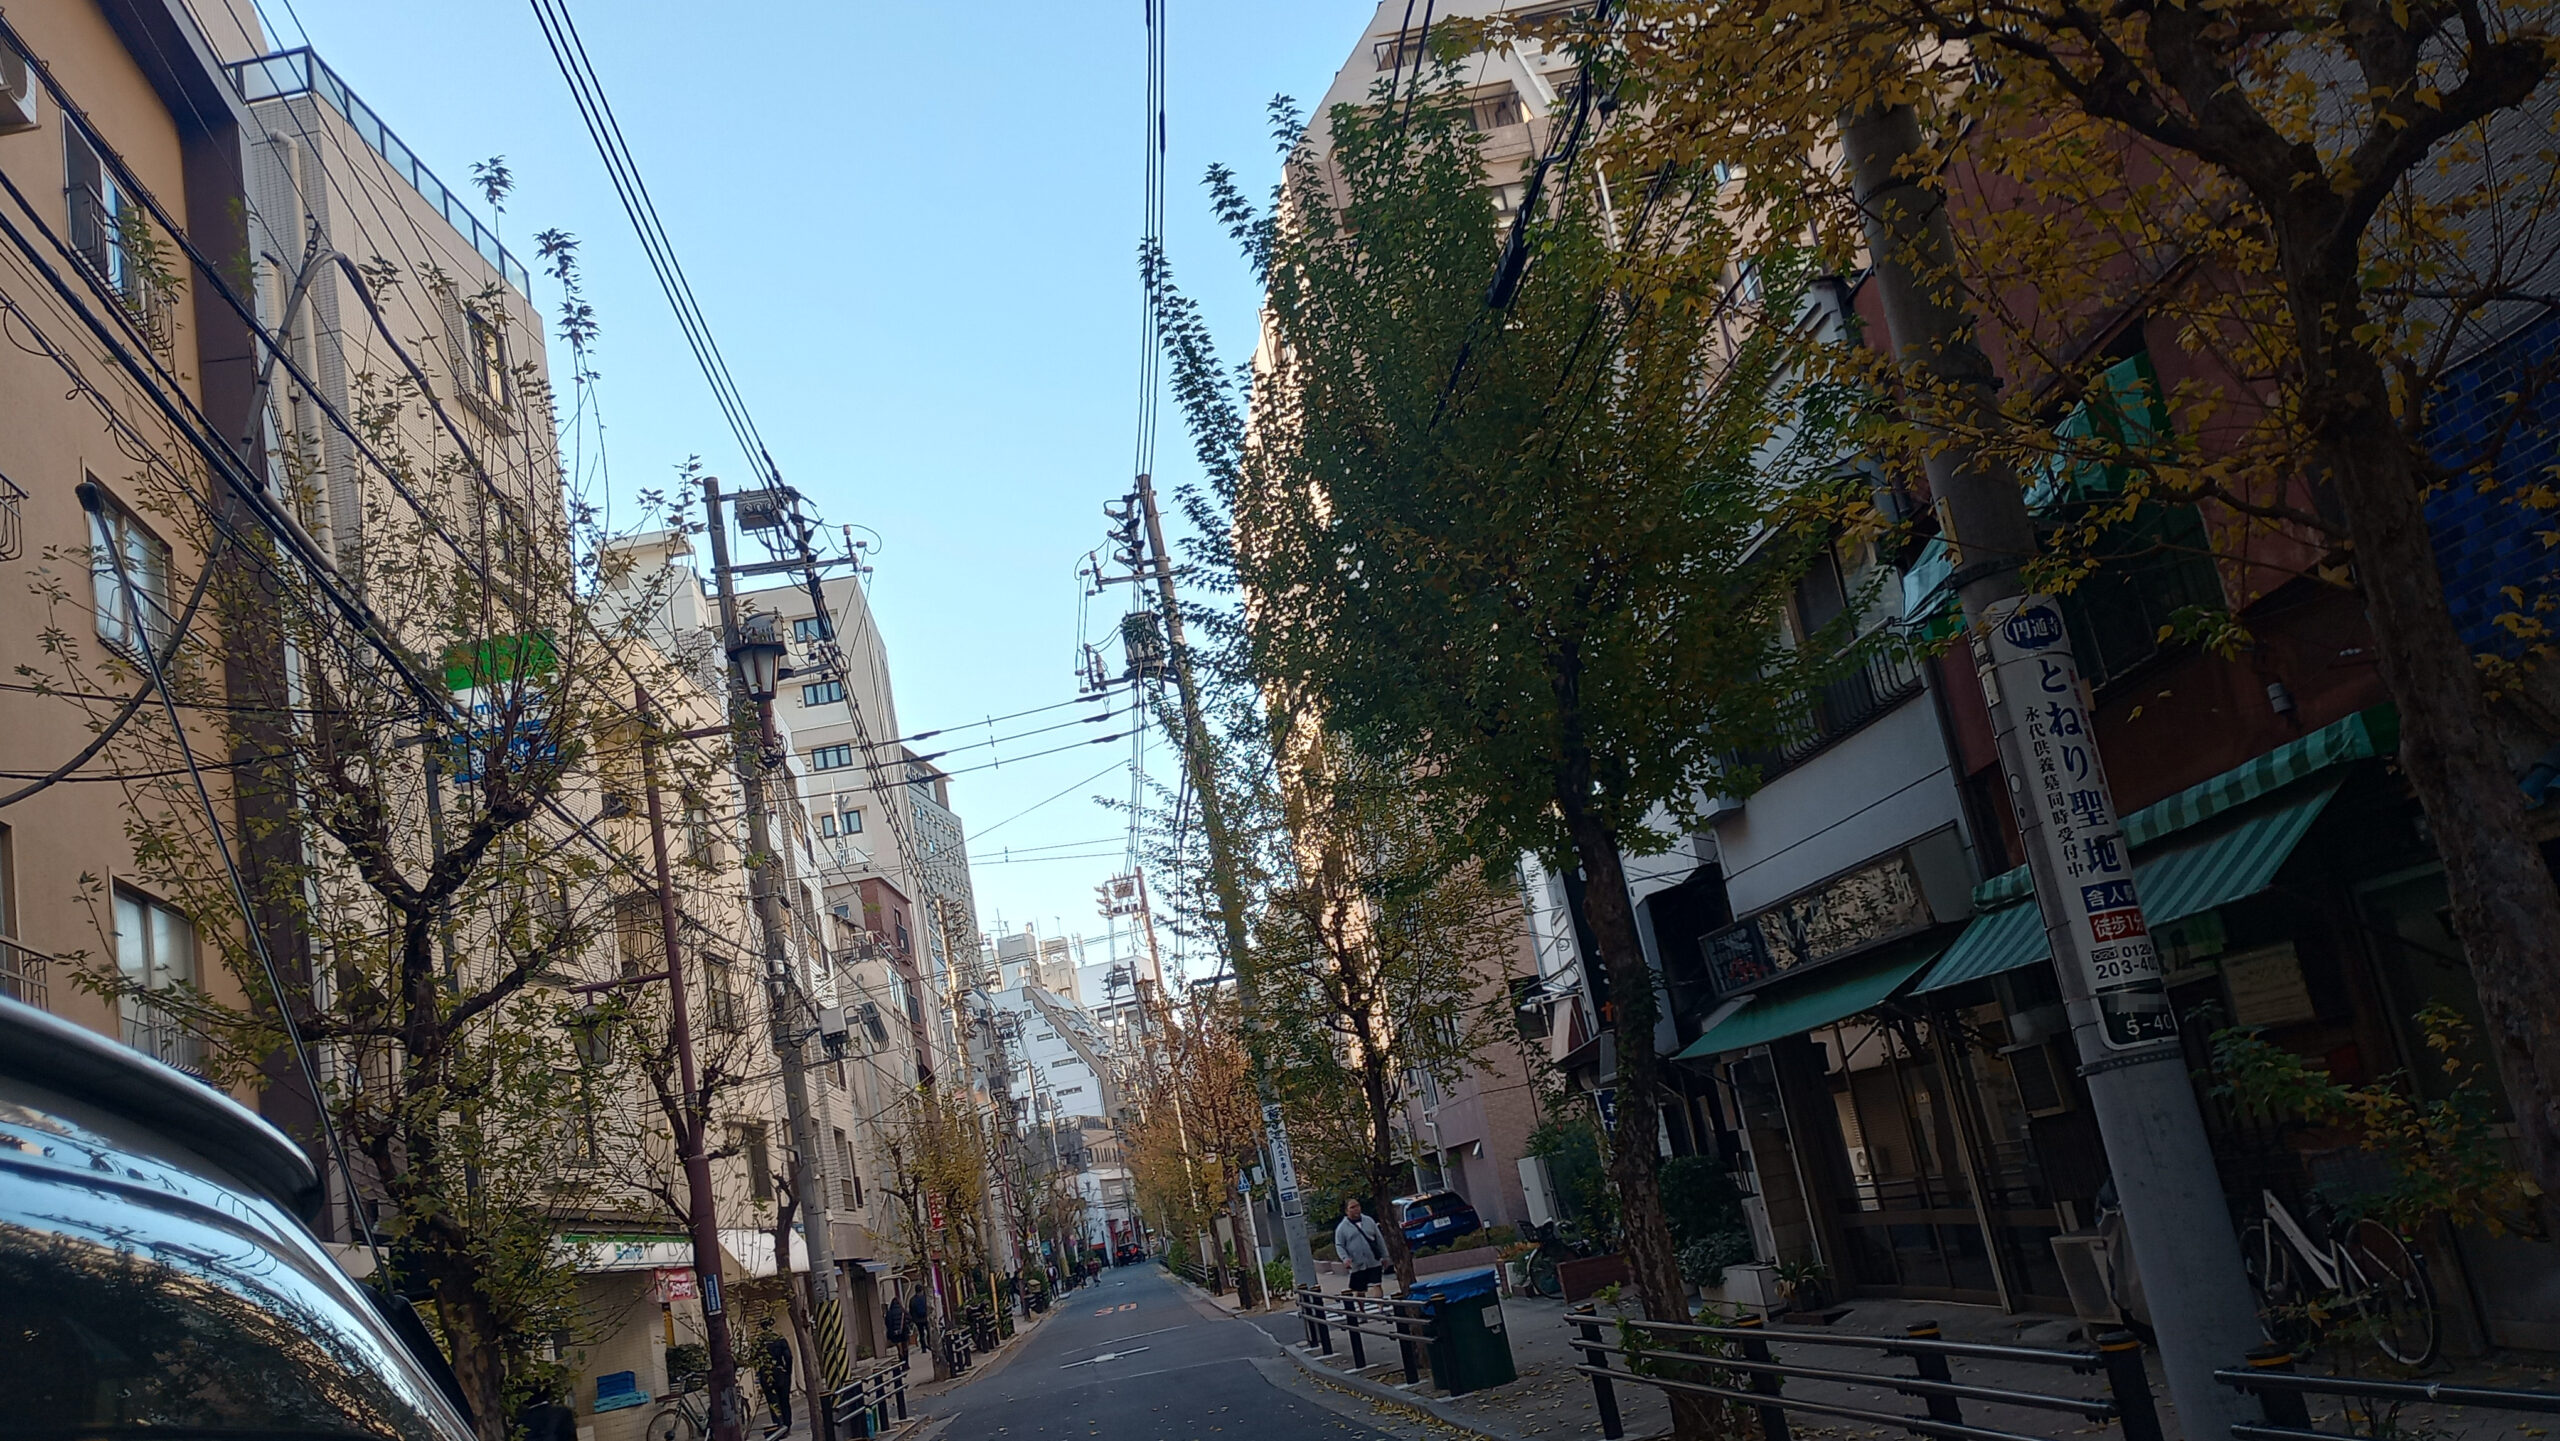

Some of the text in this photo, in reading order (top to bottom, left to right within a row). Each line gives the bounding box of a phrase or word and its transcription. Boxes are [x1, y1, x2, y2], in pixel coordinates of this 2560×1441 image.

[2012, 616, 2059, 642] 円通寺
[2025, 706, 2084, 878] 永代供養墓同時受付中
[2038, 659, 2122, 873] とねり聖地
